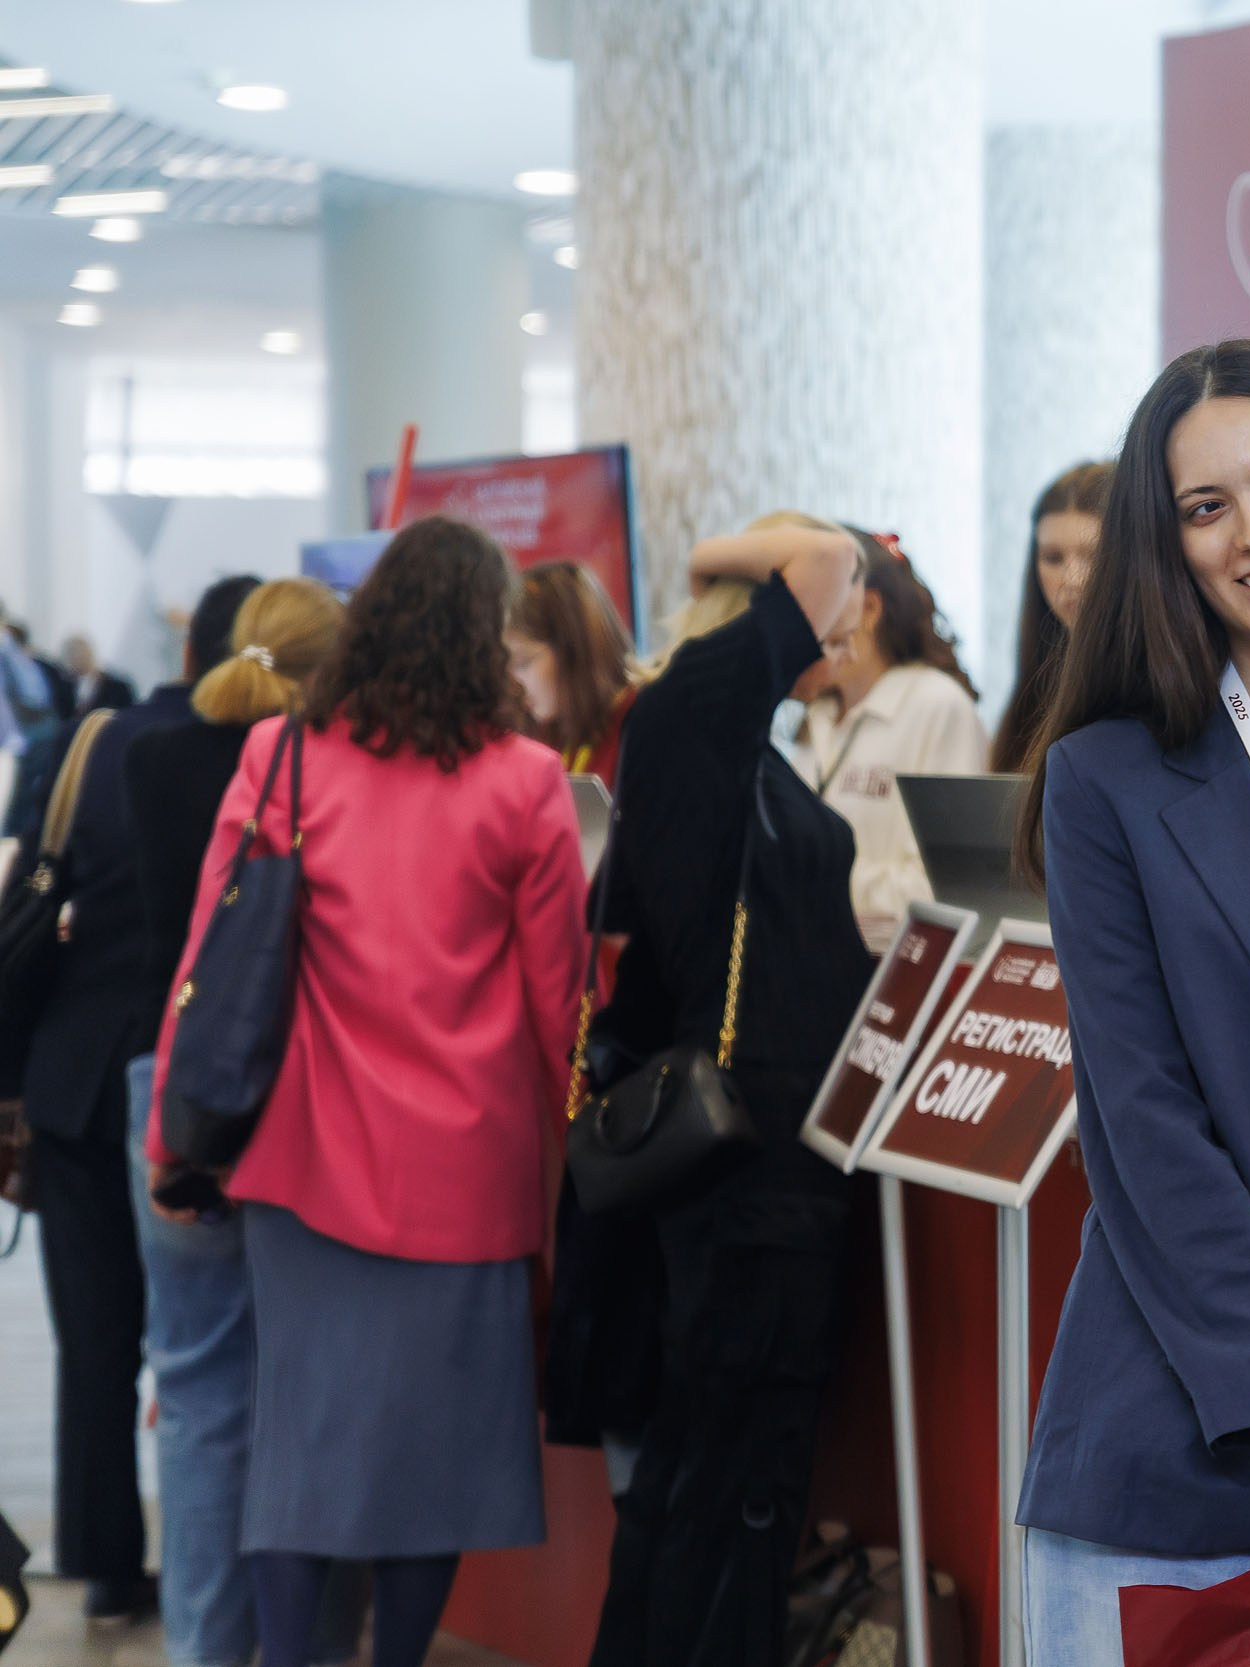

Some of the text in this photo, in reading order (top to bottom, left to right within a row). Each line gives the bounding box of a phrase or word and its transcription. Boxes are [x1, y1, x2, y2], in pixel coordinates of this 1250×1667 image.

[1228, 692, 1250, 721] 2025
[951, 1010, 1073, 1070] РЕГИСТРАЦ
[915, 1059, 1007, 1125] СМИ
